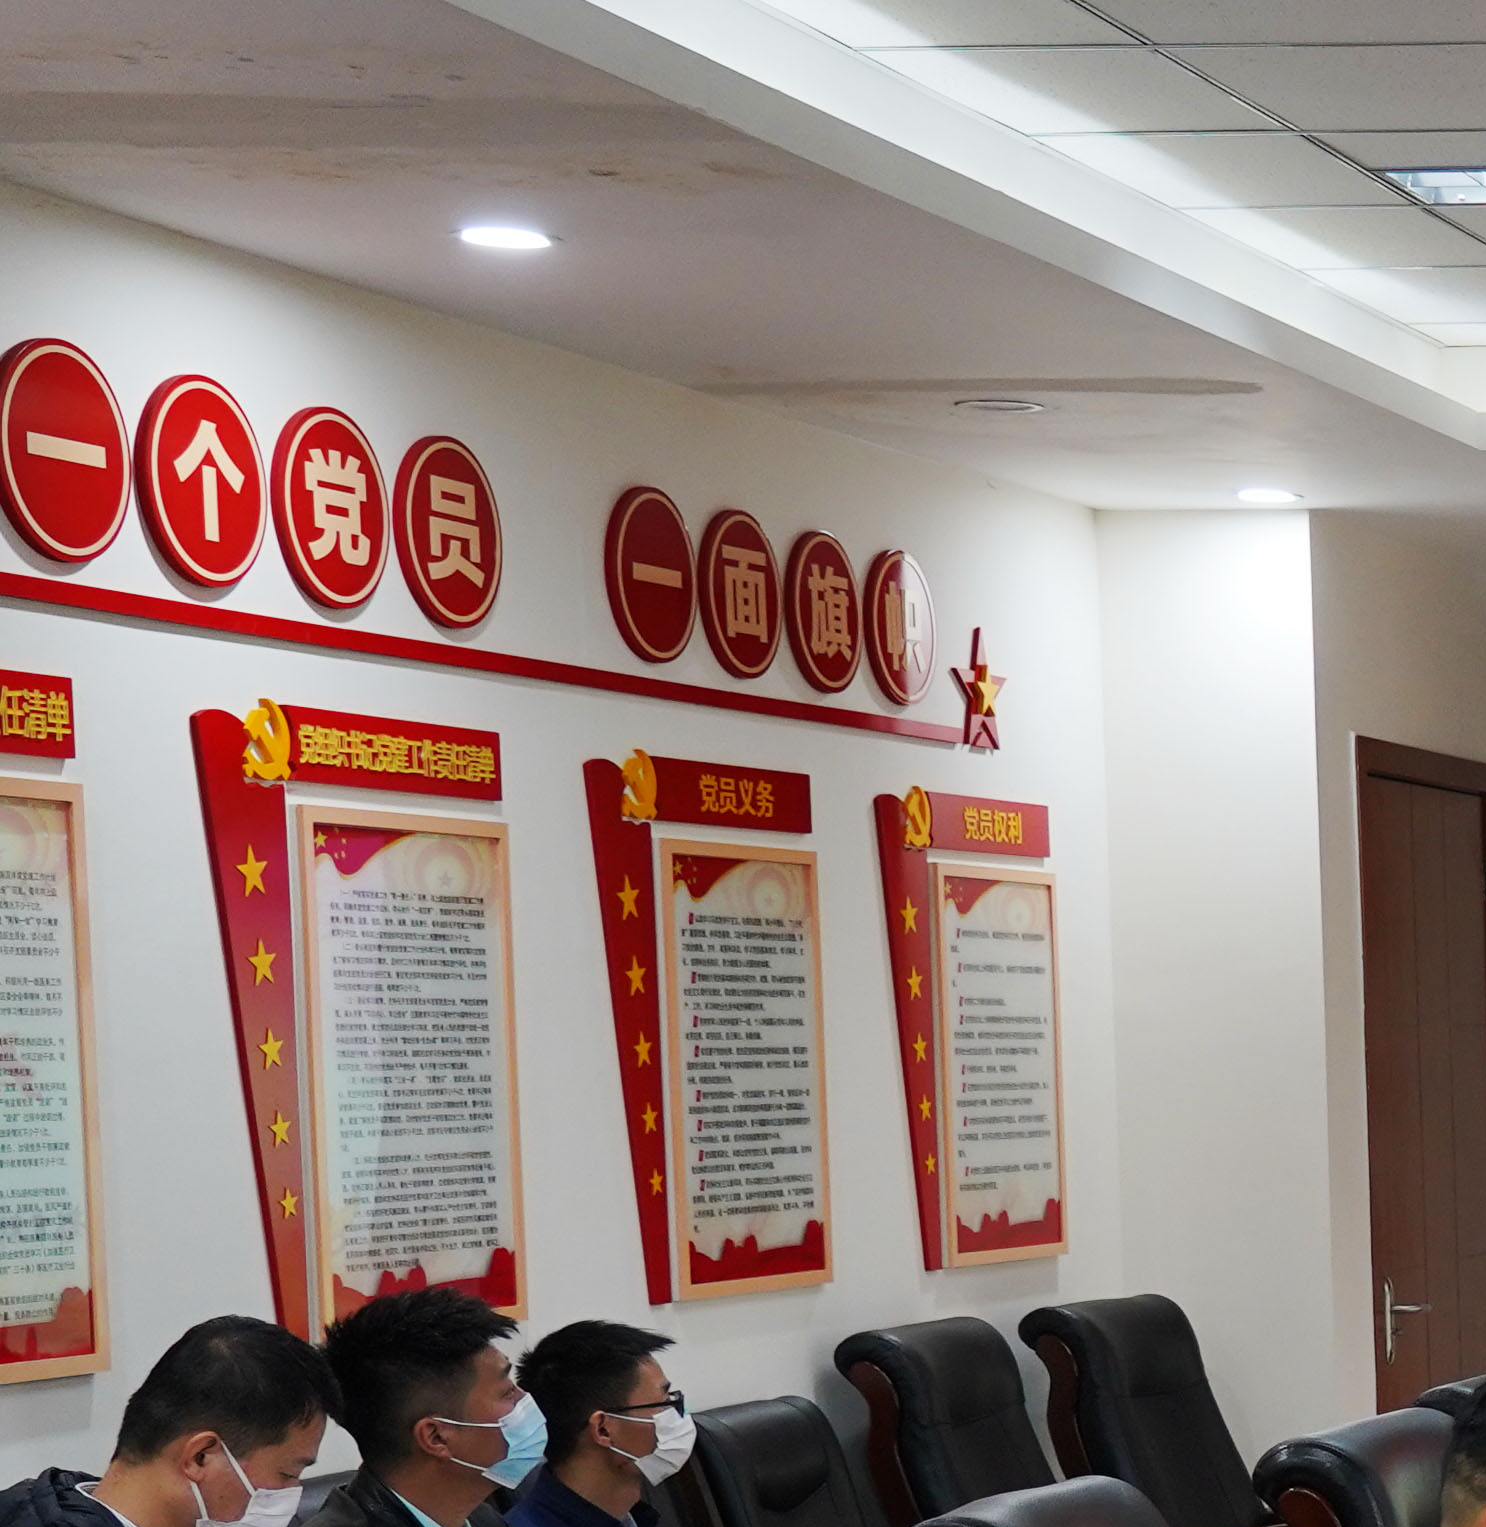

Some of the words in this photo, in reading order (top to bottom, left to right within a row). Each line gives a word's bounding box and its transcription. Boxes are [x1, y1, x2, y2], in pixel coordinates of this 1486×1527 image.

[26, 422, 484, 587] 一个党员
[631, 546, 934, 677] 一面旗帜
[699, 775, 775, 818] 党员义务
[963, 807, 1023, 844] 党员权利
